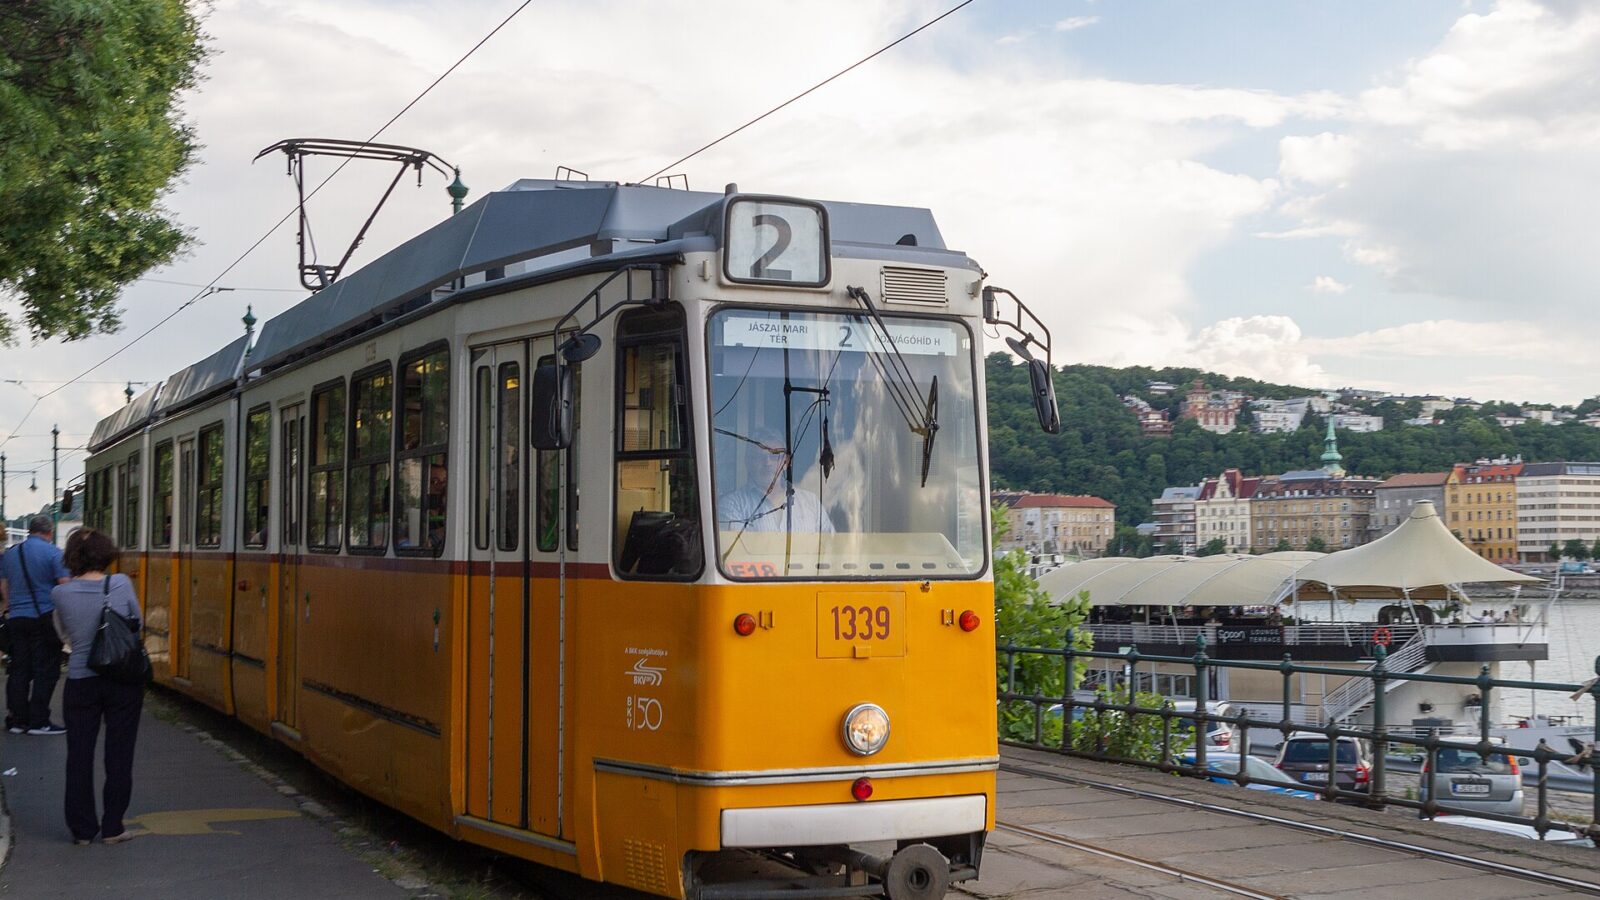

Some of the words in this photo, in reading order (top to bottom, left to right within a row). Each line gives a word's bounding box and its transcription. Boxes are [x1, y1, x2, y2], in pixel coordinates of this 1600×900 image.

[750, 214, 792, 280] 2
[748, 321, 780, 332] JÁSZAI
[783, 324, 808, 334] MARI
[769, 333, 788, 344] TÉR
[839, 325, 853, 347] 2
[831, 605, 890, 640] 1339
[637, 697, 663, 731] 50
